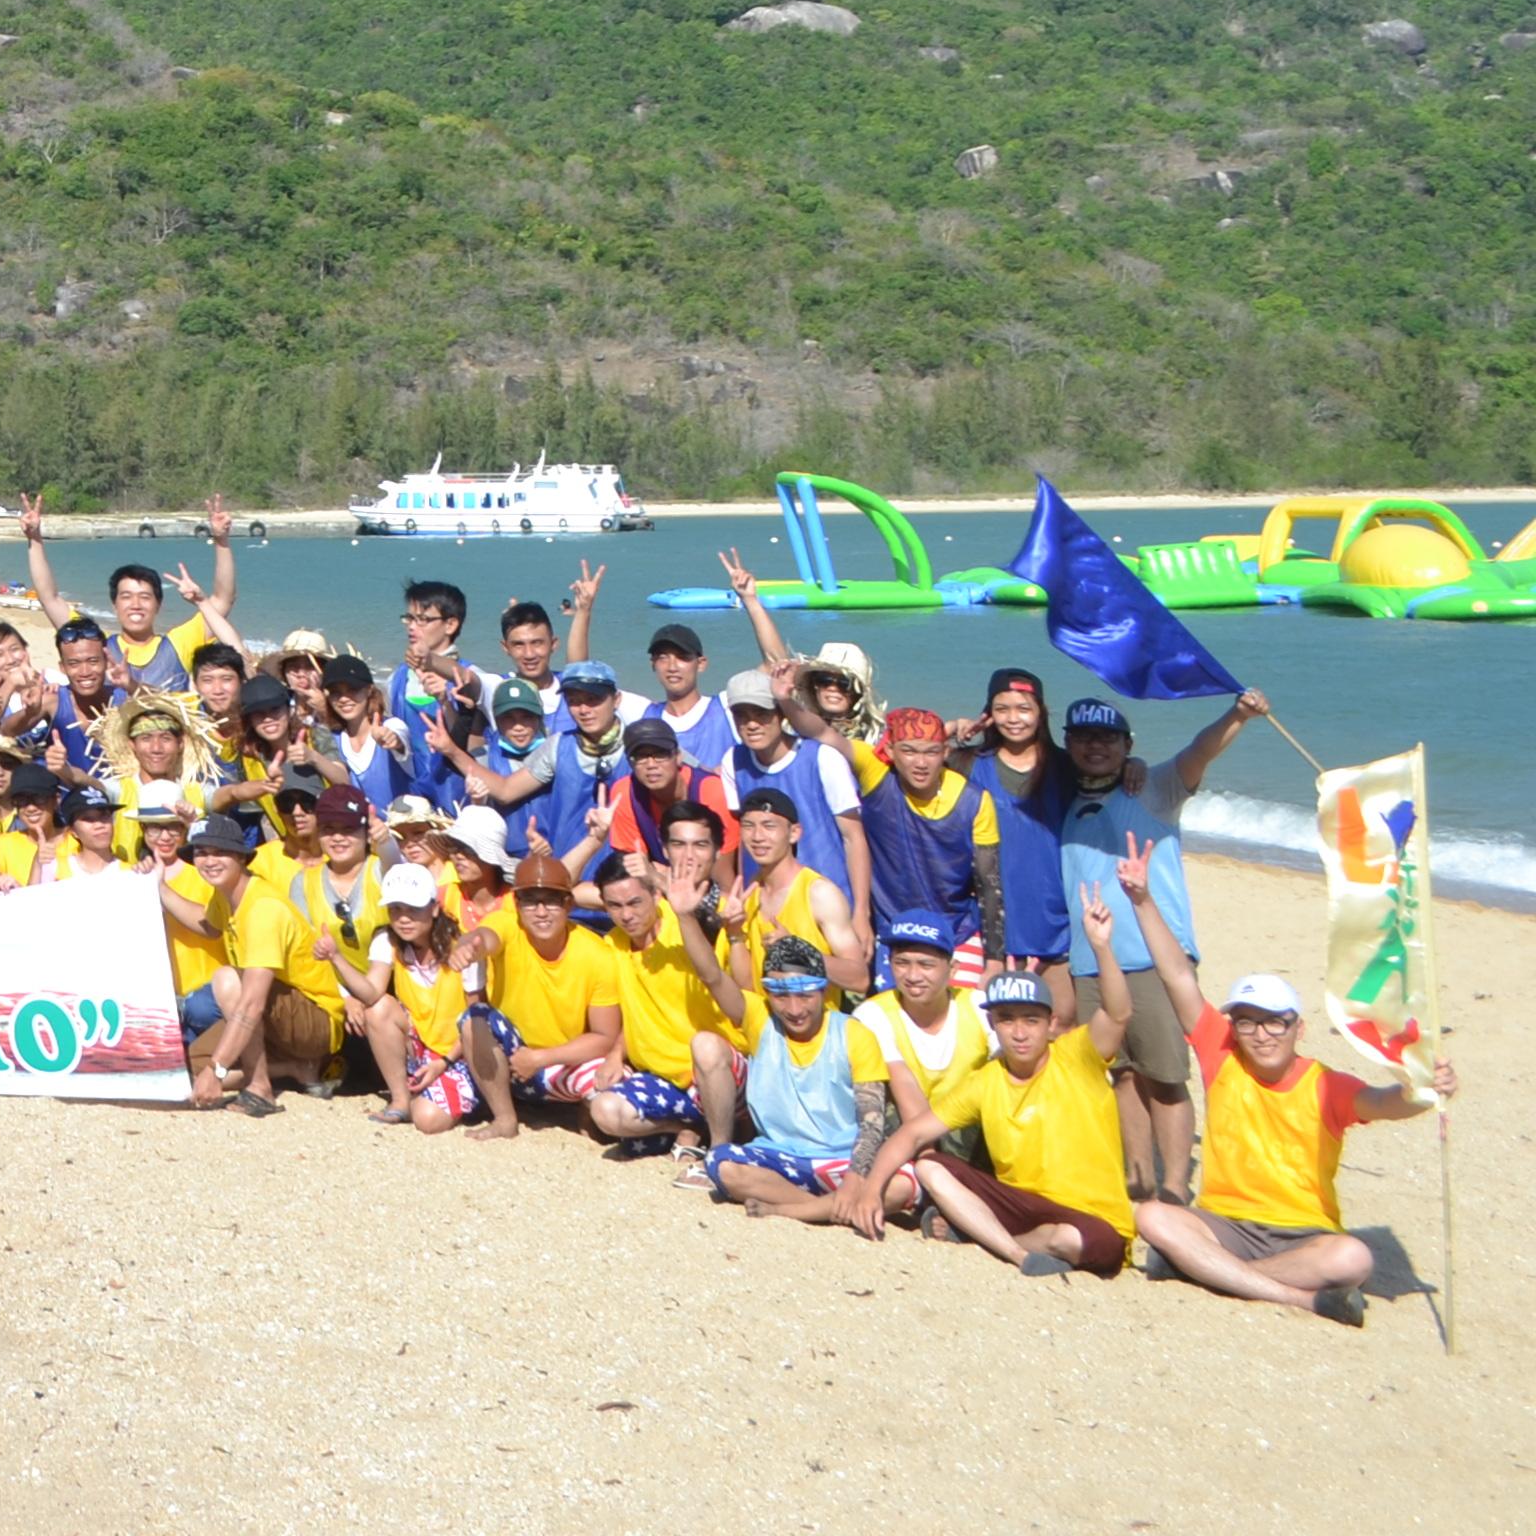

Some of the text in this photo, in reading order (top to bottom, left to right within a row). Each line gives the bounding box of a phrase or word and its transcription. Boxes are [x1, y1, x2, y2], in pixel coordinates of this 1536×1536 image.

[1072, 704, 1116, 724] WHAT!
[892, 923, 939, 940] UNCAGE
[989, 976, 1036, 1000] WHAT!
